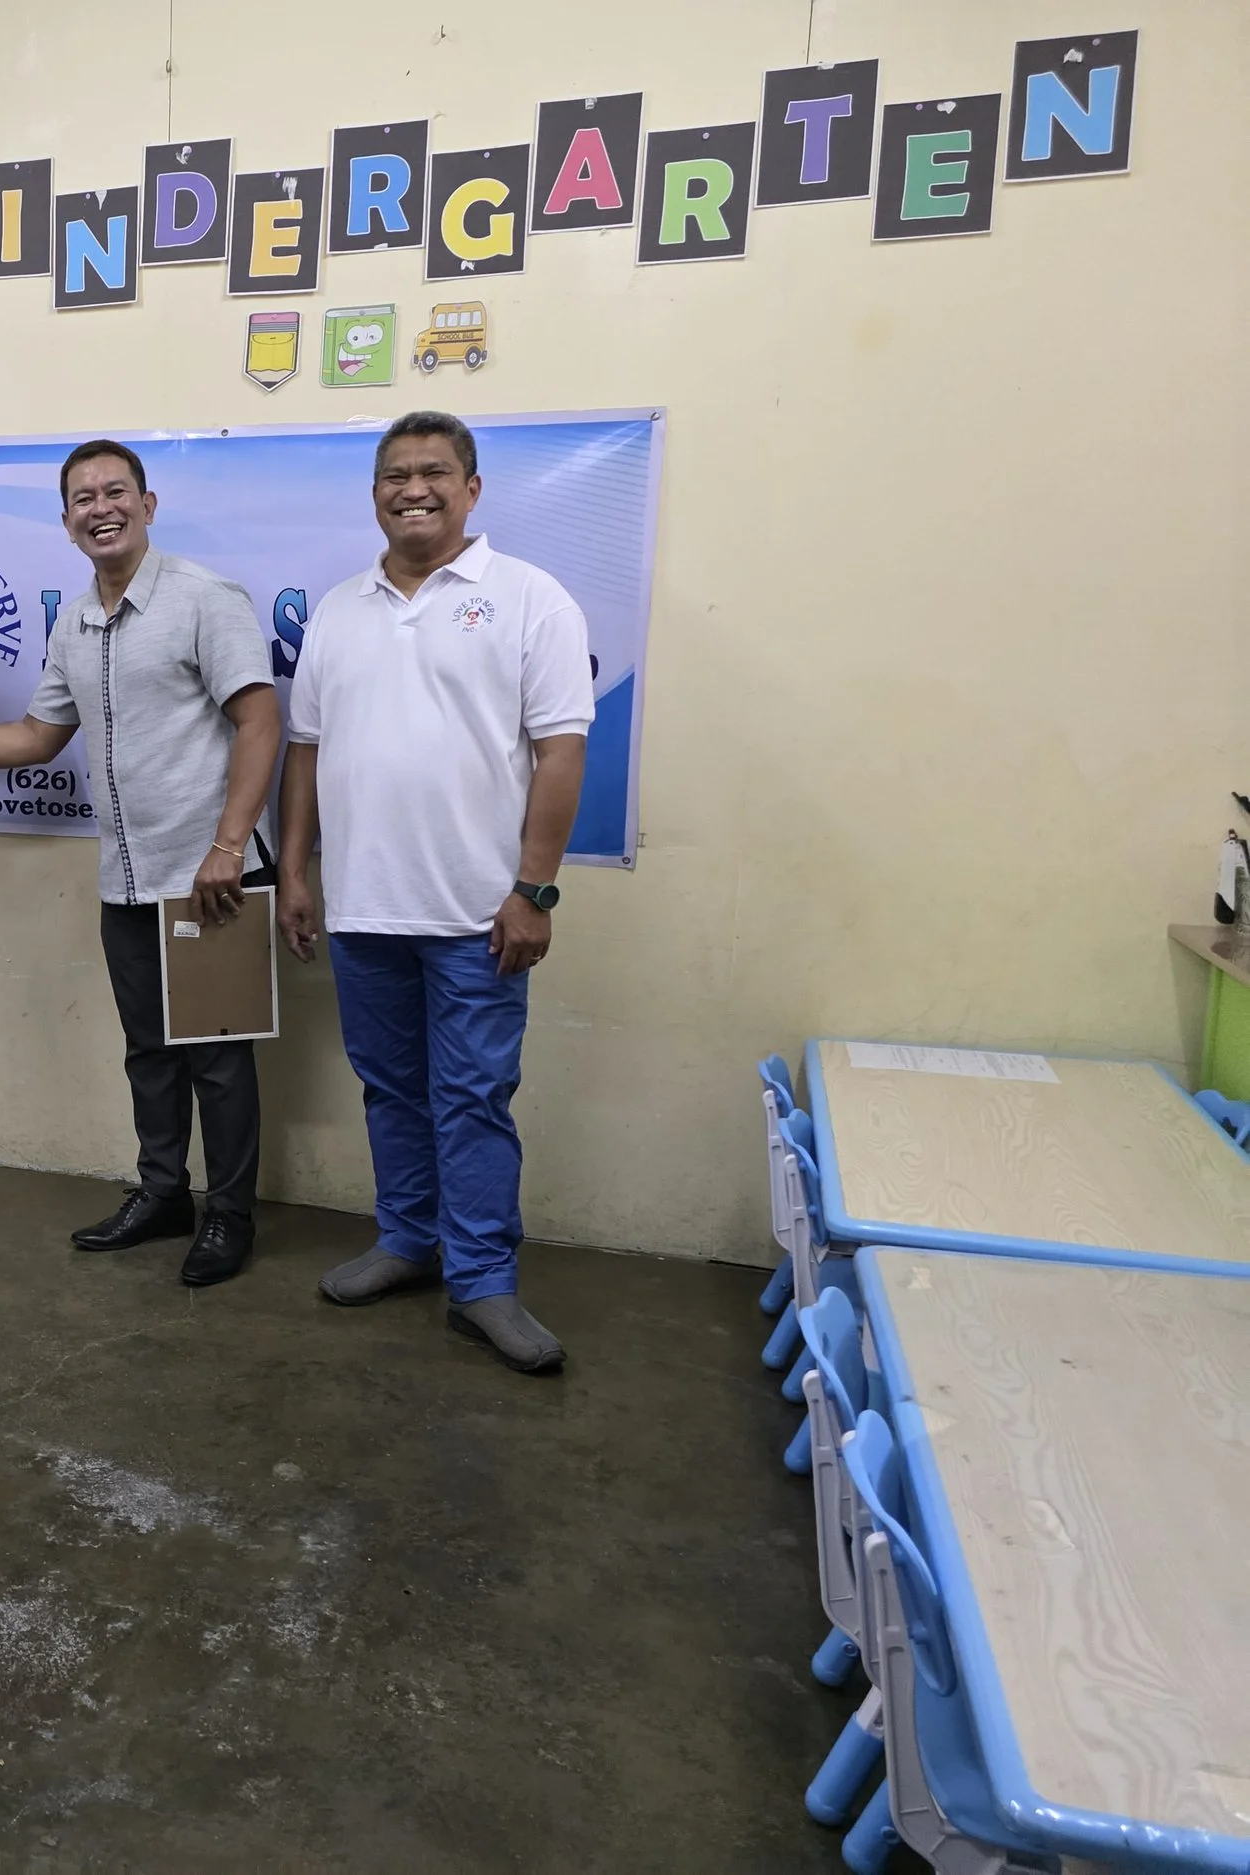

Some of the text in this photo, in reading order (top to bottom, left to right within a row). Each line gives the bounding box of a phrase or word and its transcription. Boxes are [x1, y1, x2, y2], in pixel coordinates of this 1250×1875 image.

[438, 333, 460, 341] SCHOOL
[452, 597, 495, 625] LOVE TO SERVE
[6, 768, 76, 797] (626)
